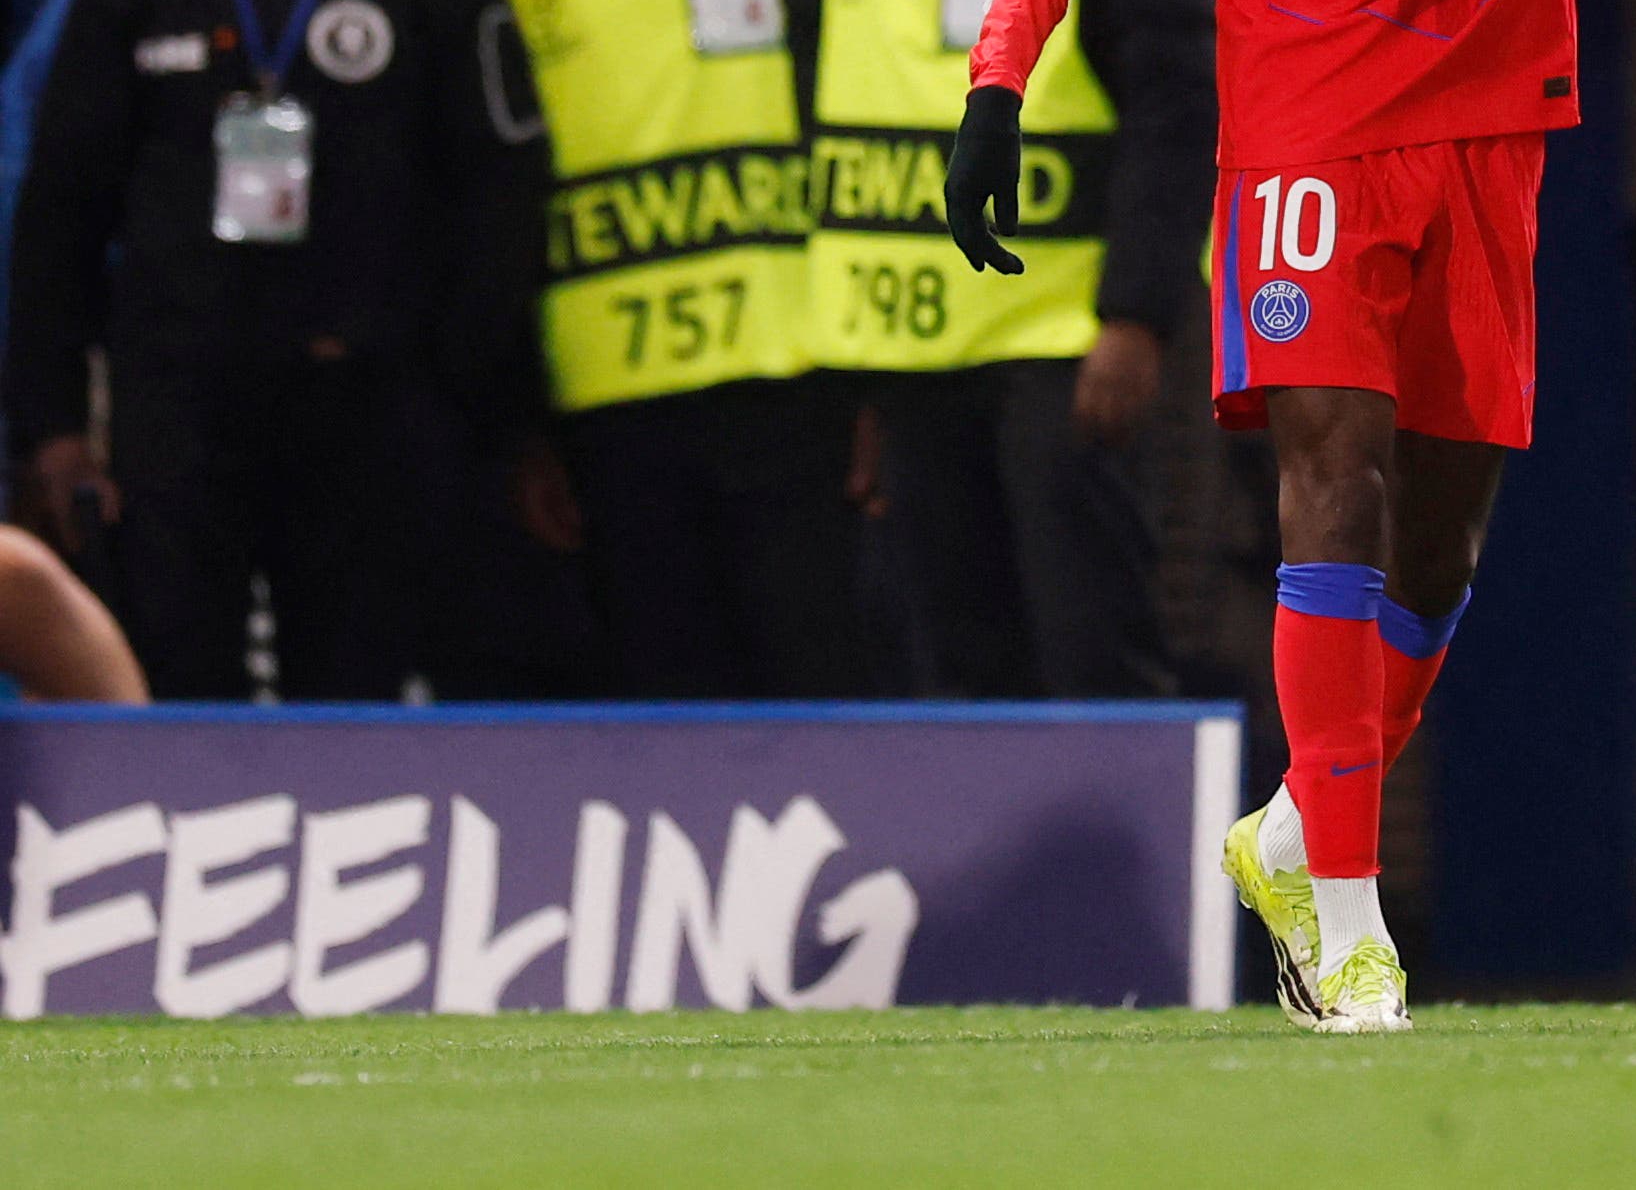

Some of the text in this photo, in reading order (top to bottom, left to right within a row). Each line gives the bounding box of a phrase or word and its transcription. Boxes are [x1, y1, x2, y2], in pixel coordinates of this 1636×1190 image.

[811, 136, 1074, 225] TEWAD
[1254, 174, 1338, 272] 10
[606, 275, 745, 371] 757
[1261, 283, 1299, 299] PARIS
[0, 794, 919, 1019] FEELING
